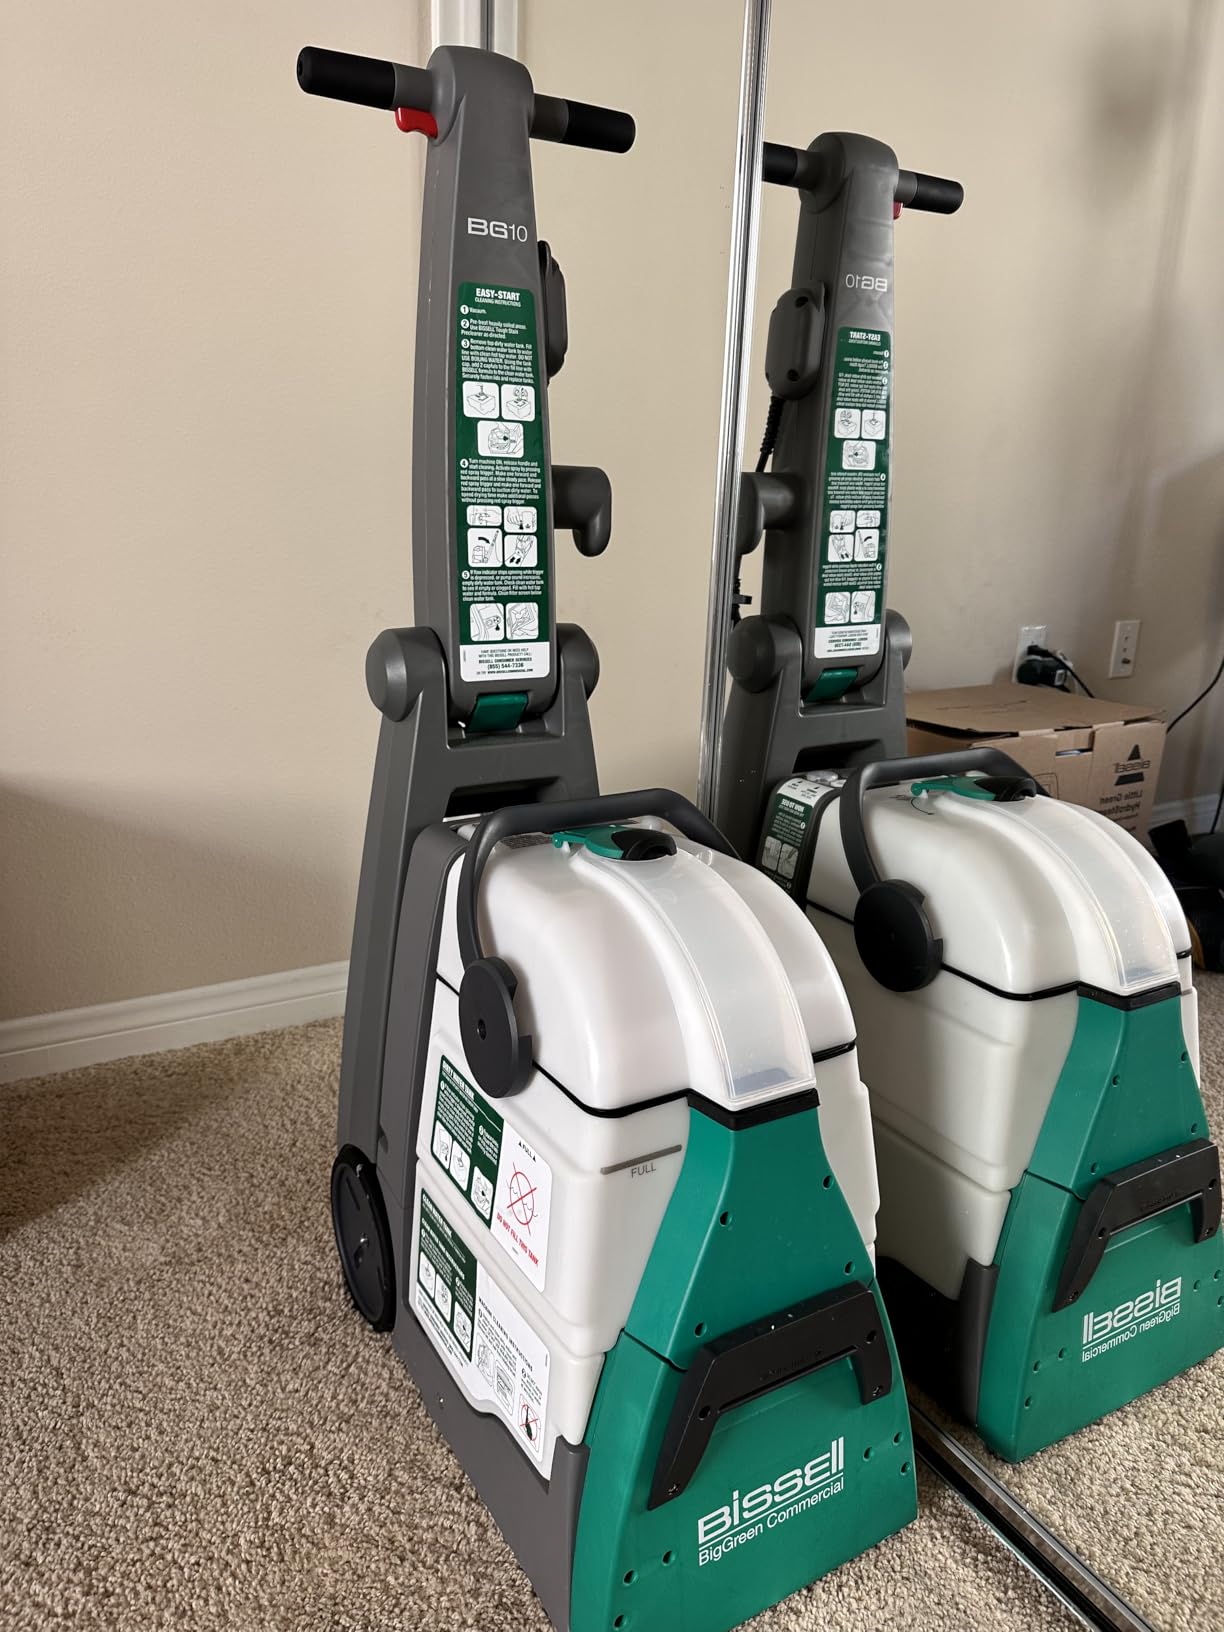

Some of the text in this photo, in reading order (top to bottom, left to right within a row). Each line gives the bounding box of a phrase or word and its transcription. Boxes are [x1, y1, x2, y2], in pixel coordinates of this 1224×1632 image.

[468, 217, 528, 242] BG10
[476, 288, 520, 301] EASY-START
[631, 1162, 656, 1178] FULL
[496, 1212, 504, 1223] DO
[519, 1238, 527, 1253] THIS
[528, 1249, 538, 1265] TANK
[698, 1476, 844, 1566] BigGreen Commercial
